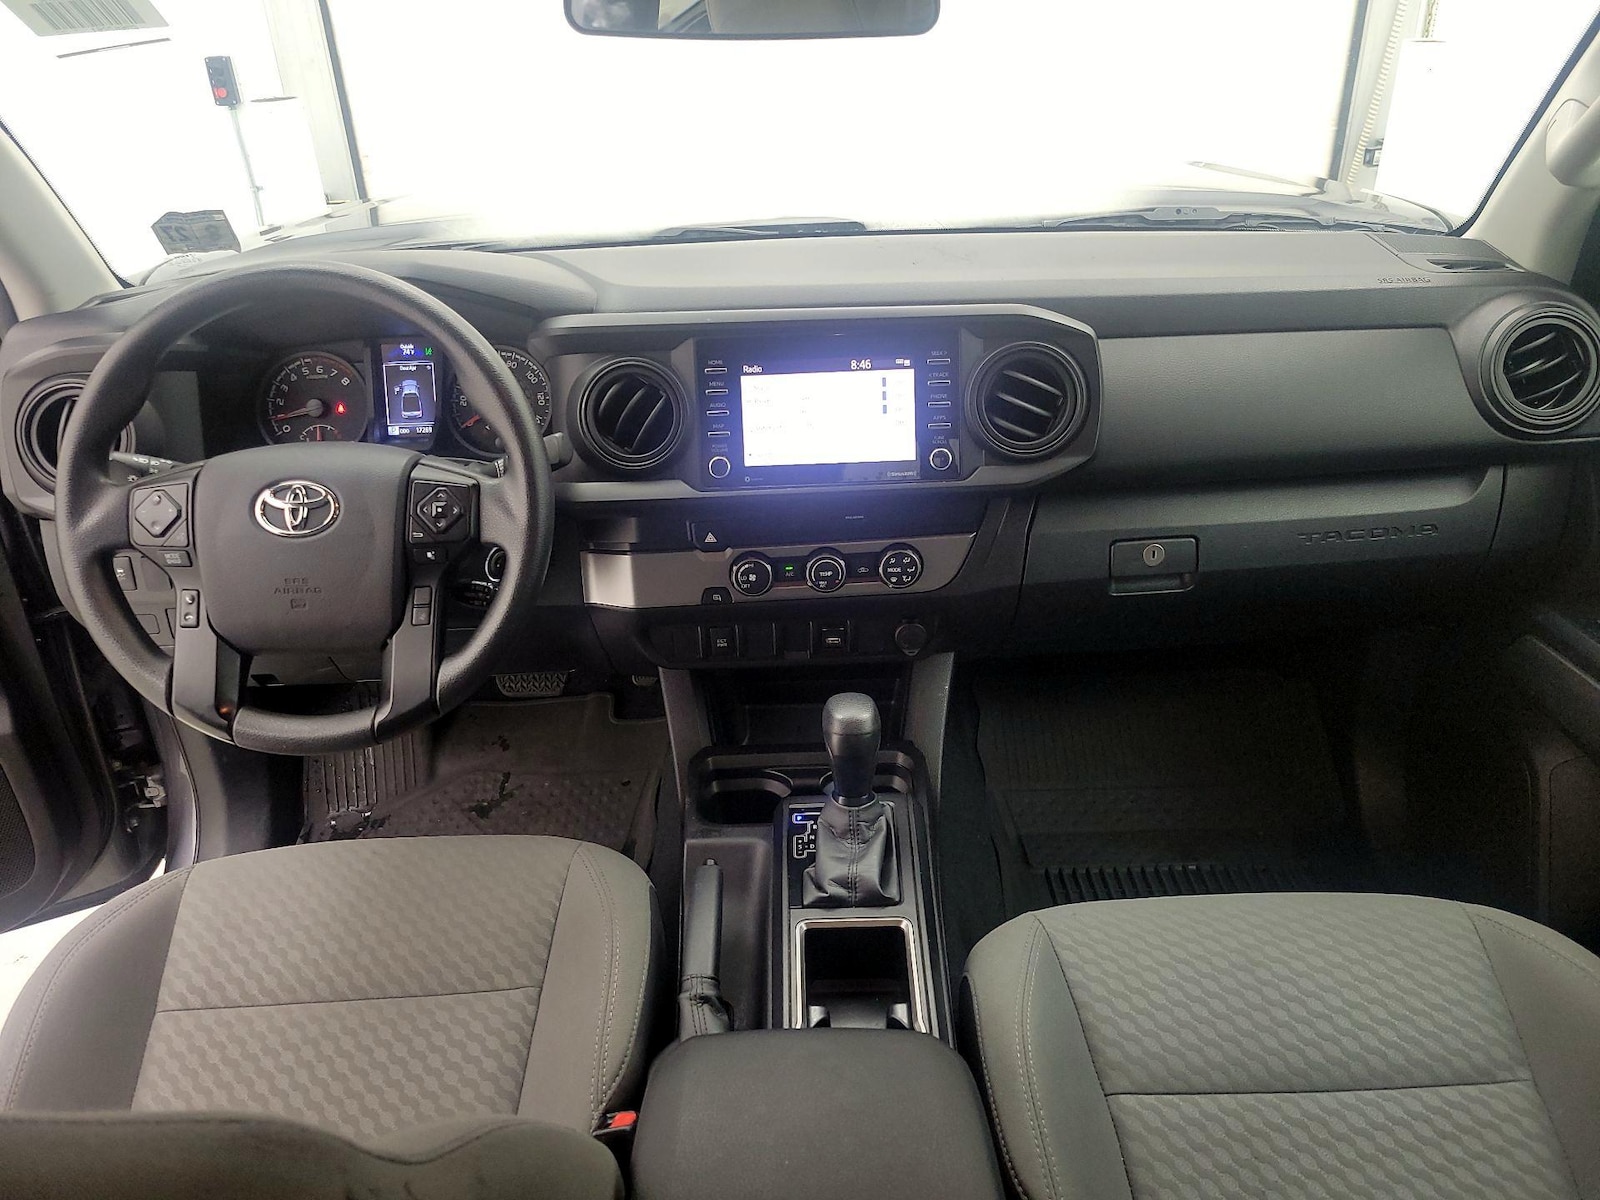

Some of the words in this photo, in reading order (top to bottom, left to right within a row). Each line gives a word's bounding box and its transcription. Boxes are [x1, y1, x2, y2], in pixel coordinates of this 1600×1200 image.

[743, 365, 762, 373] Radio
[850, 359, 872, 370] 8:46
[302, 367, 310, 376] 5
[316, 366, 324, 374] 6
[330, 368, 338, 377] 7
[290, 373, 298, 382] 4
[340, 377, 350, 386] 8
[526, 370, 538, 384] 100
[280, 384, 288, 392] 3
[276, 398, 284, 406] 2
[460, 395, 468, 406] 20
[536, 392, 546, 406] 120
[282, 424, 291, 432] 0
[1297, 523, 1439, 545] TACOMA
